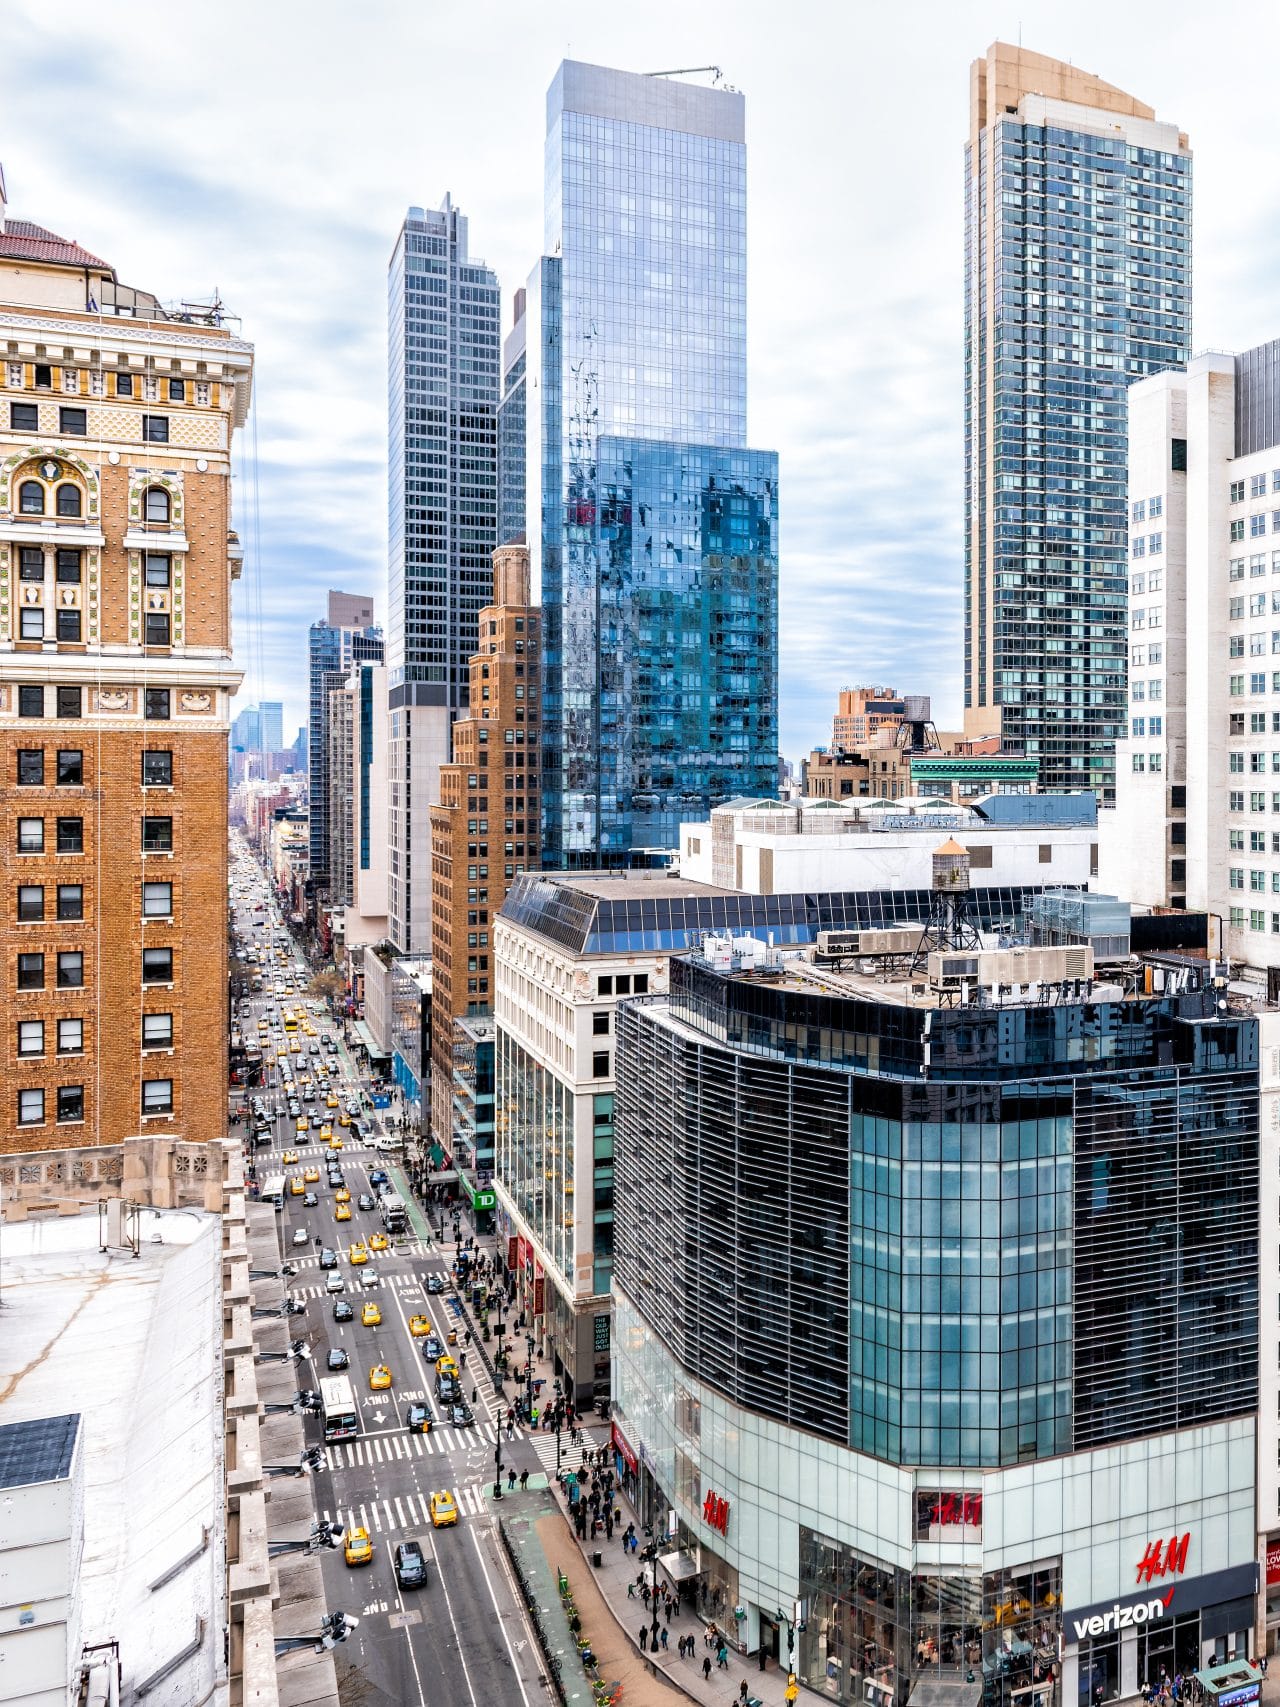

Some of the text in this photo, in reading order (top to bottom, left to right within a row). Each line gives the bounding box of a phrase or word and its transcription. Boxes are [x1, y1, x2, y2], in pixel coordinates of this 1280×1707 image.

[477, 1195, 495, 1206] TD
[362, 1394, 389, 1407] ONLY
[399, 1390, 425, 1402] ONLY
[703, 1488, 729, 1537] H&M
[1136, 1532, 1191, 1584] H&M
[1073, 1599, 1164, 1639] verizon
